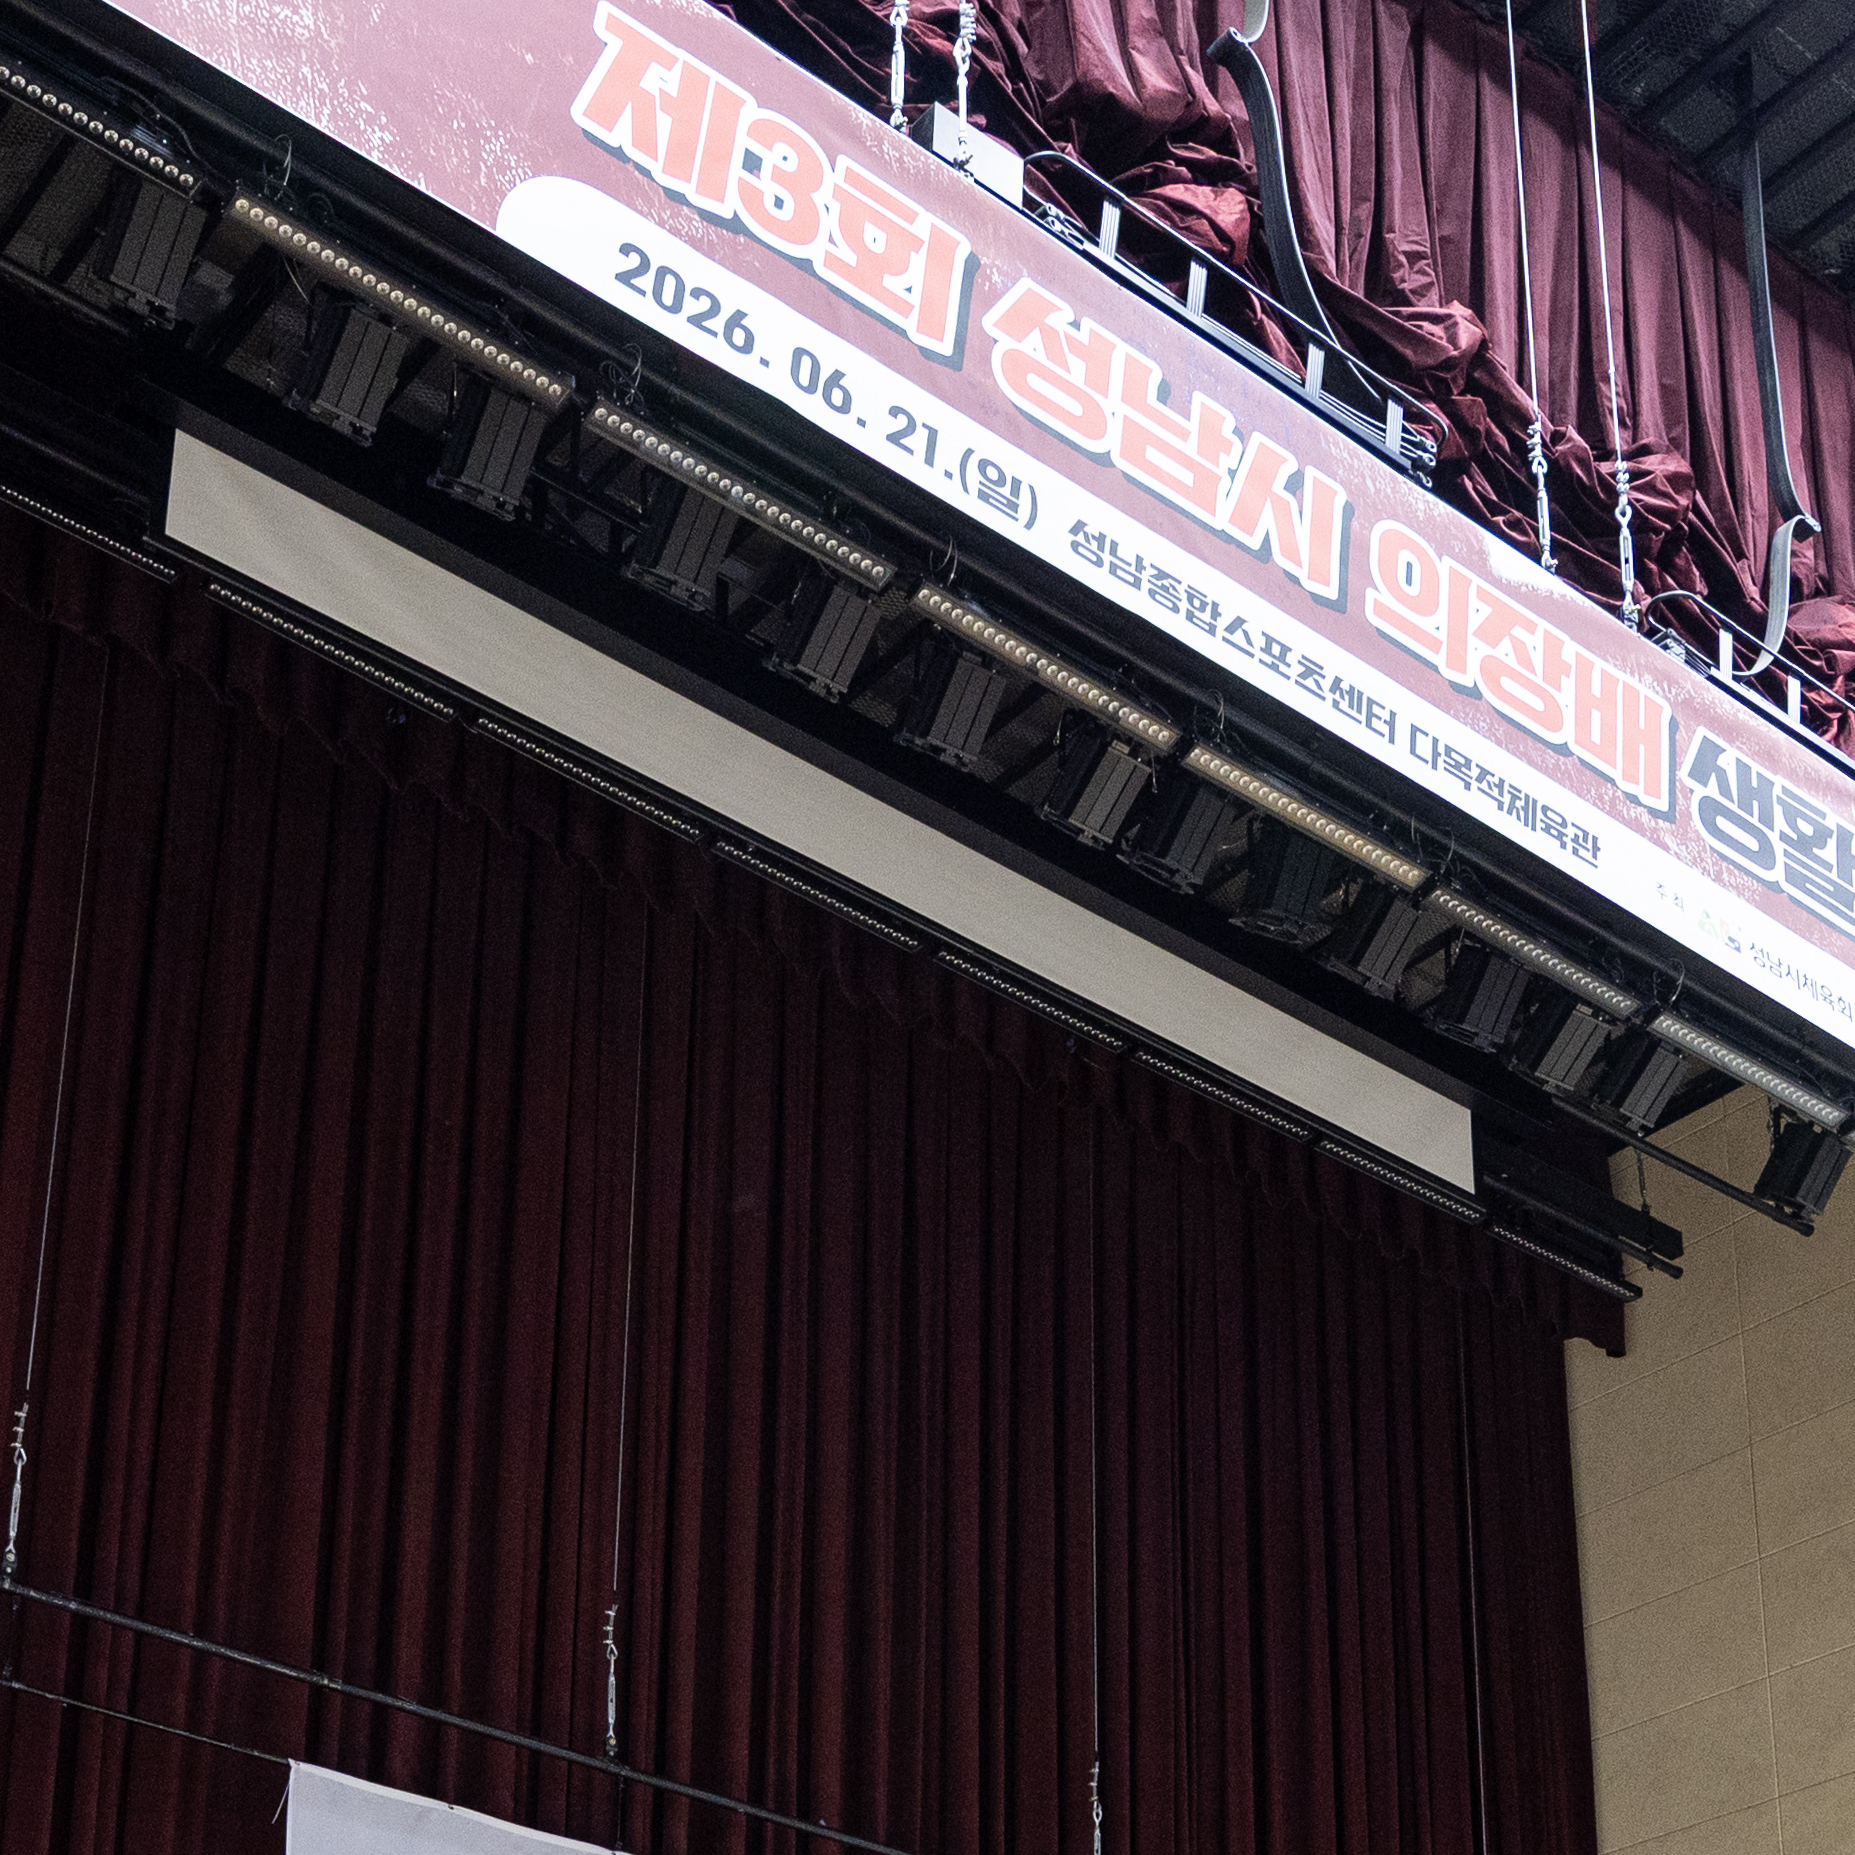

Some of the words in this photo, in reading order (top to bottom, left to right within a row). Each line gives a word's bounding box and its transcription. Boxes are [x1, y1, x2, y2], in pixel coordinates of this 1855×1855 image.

[577, 6, 965, 350] 제3회
[989, 284, 1341, 594] 성남시
[1372, 526, 1668, 802] 의장배
[613, 239, 771, 365] 2026.
[788, 343, 867, 428] 06.
[1068, 518, 1397, 747] 성남종합스포츠센터
[1407, 722, 1602, 871] 다목적체육관
[1749, 942, 1854, 1023] 성남시체육회
